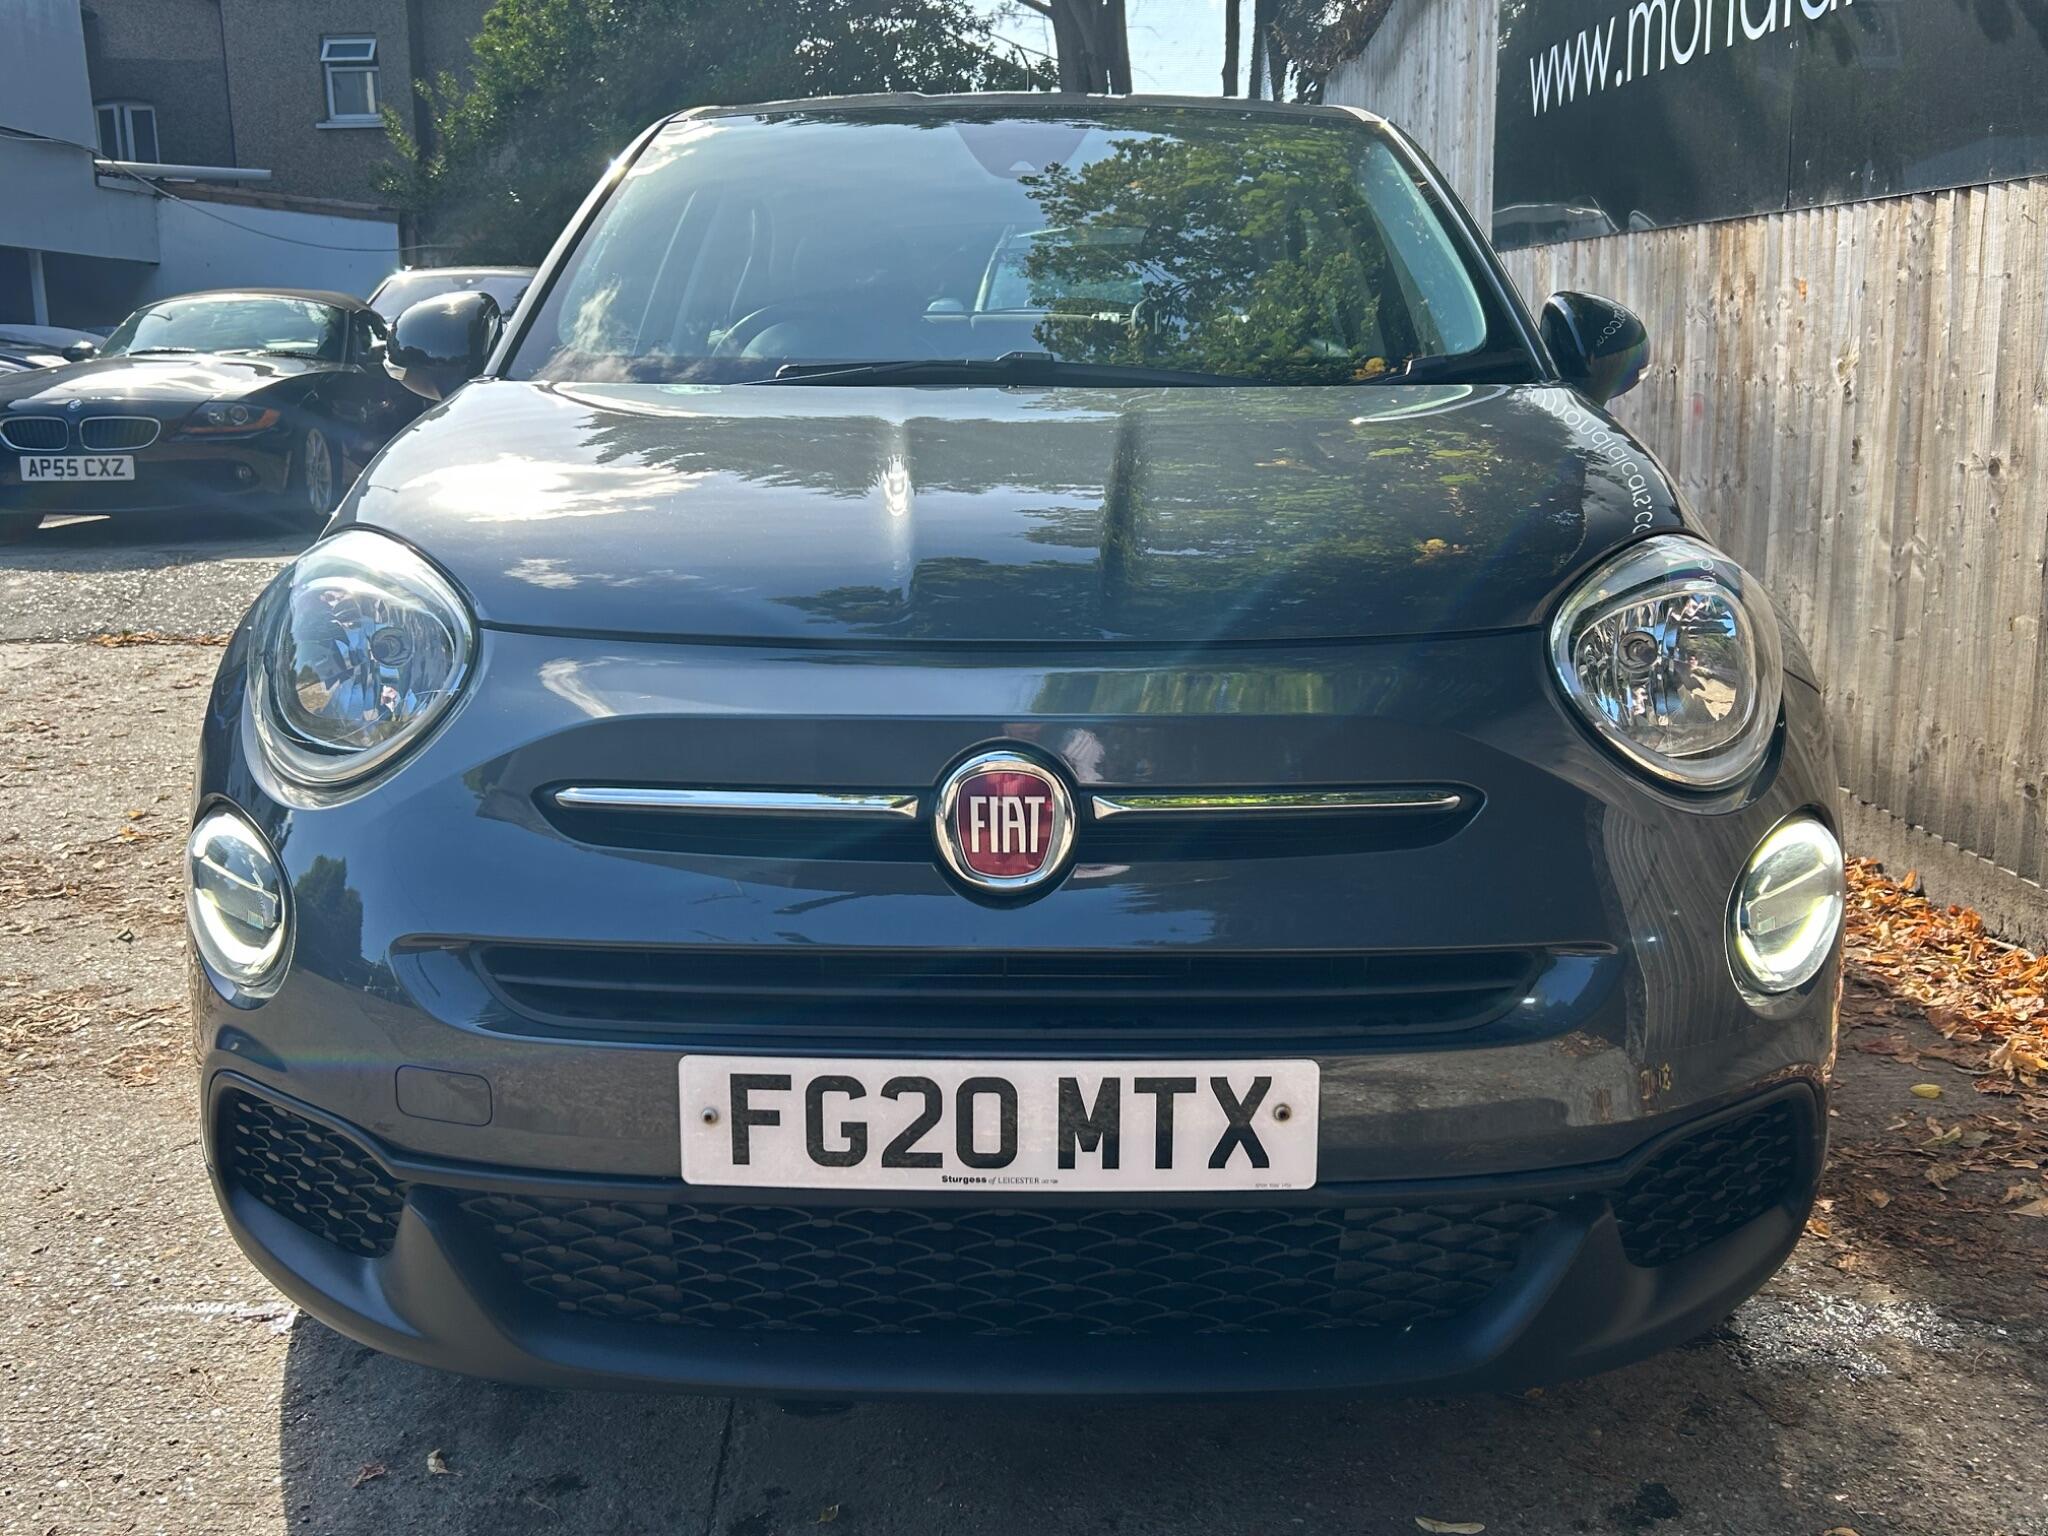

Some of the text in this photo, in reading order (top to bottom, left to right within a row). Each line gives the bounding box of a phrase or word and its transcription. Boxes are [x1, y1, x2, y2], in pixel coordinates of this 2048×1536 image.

[1530, 0, 1853, 117] www.mon
[28, 458, 126, 477] AP55 CXZ
[970, 796, 1046, 854] FIAT
[729, 1073, 1273, 1170] FG20 MTX
[941, 1175, 987, 1185] Sturgess
[988, 1176, 997, 1185] of
